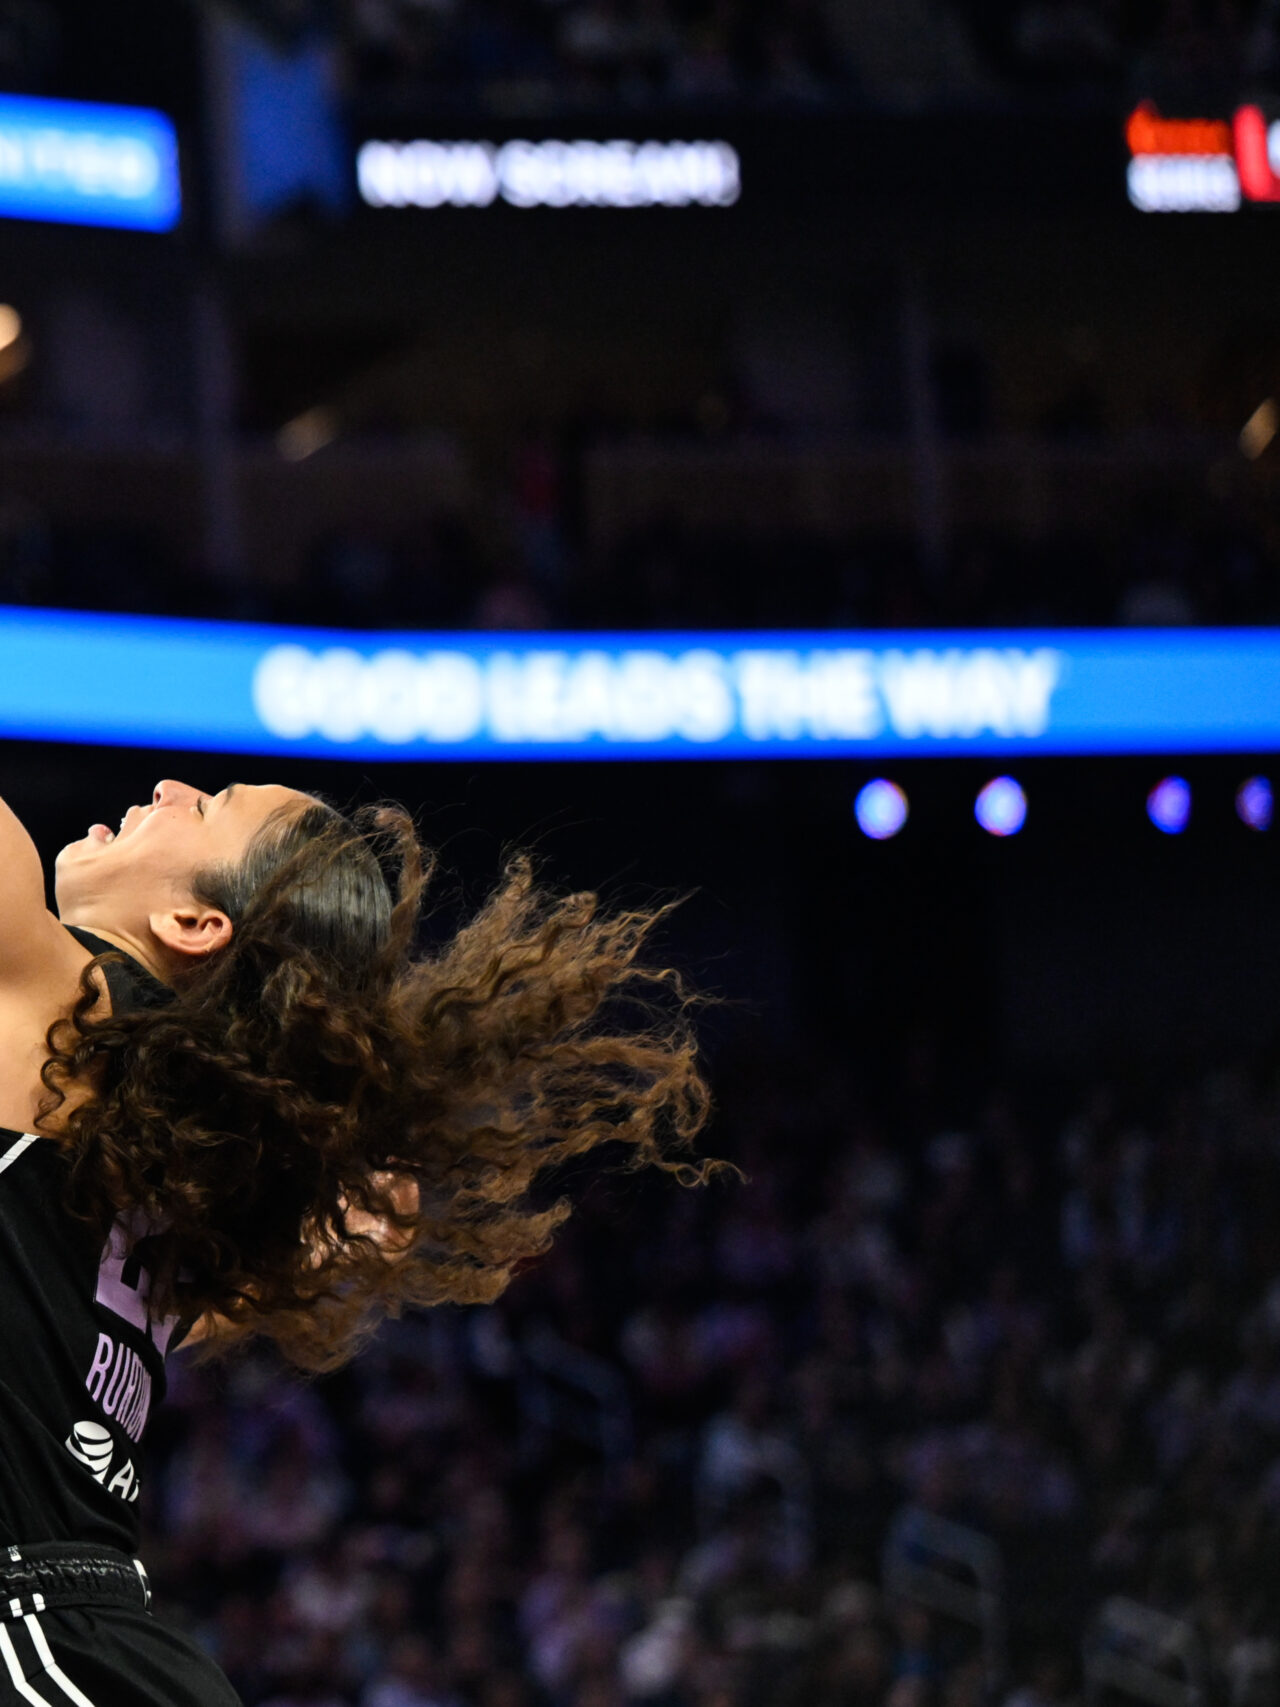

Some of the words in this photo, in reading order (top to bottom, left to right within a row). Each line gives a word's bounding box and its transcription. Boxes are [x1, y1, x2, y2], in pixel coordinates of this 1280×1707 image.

[252, 645, 483, 743] GOOD
[485, 649, 735, 743] LEADS
[737, 649, 882, 739] THE
[883, 649, 1062, 738] WAY
